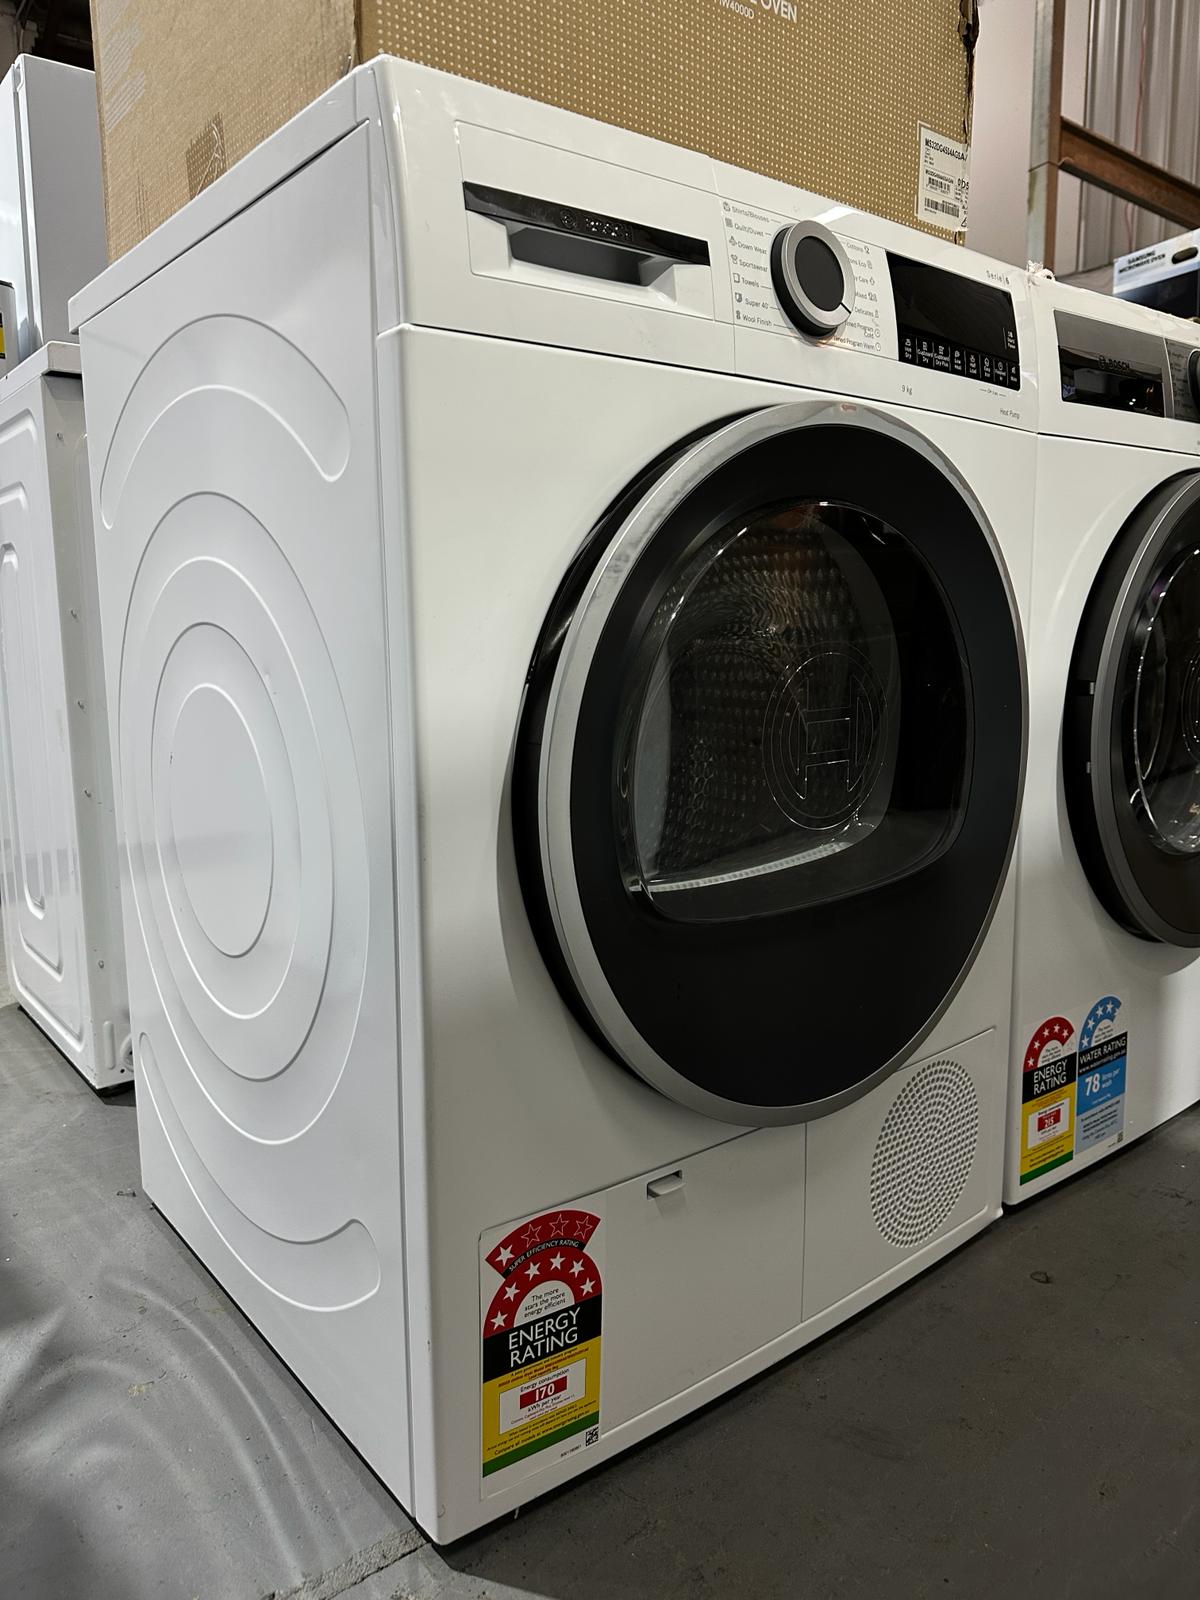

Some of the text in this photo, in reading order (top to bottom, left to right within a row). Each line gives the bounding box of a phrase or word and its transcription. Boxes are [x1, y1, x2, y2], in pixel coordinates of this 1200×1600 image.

[761, 0, 797, 24] OVEN
[1079, 1047, 1103, 1065] WATER
[1102, 1037, 1127, 1055] RATING
[1033, 1059, 1068, 1084] ENERGY
[1033, 1071, 1068, 1096] RATING
[1085, 1073, 1101, 1096] 78
[509, 1239, 580, 1272] SUPER EFFICIENCY RATING
[524, 1292, 566, 1312] stars the more
[532, 1288, 560, 1303] The more
[524, 1298, 566, 1319] energy efficient
[508, 1306, 581, 1351] ENERGY
[510, 1326, 579, 1368] RATING
[520, 1368, 570, 1393] Energy consumption
[535, 1383, 555, 1402] 170
[527, 1394, 563, 1413] kWh per year
